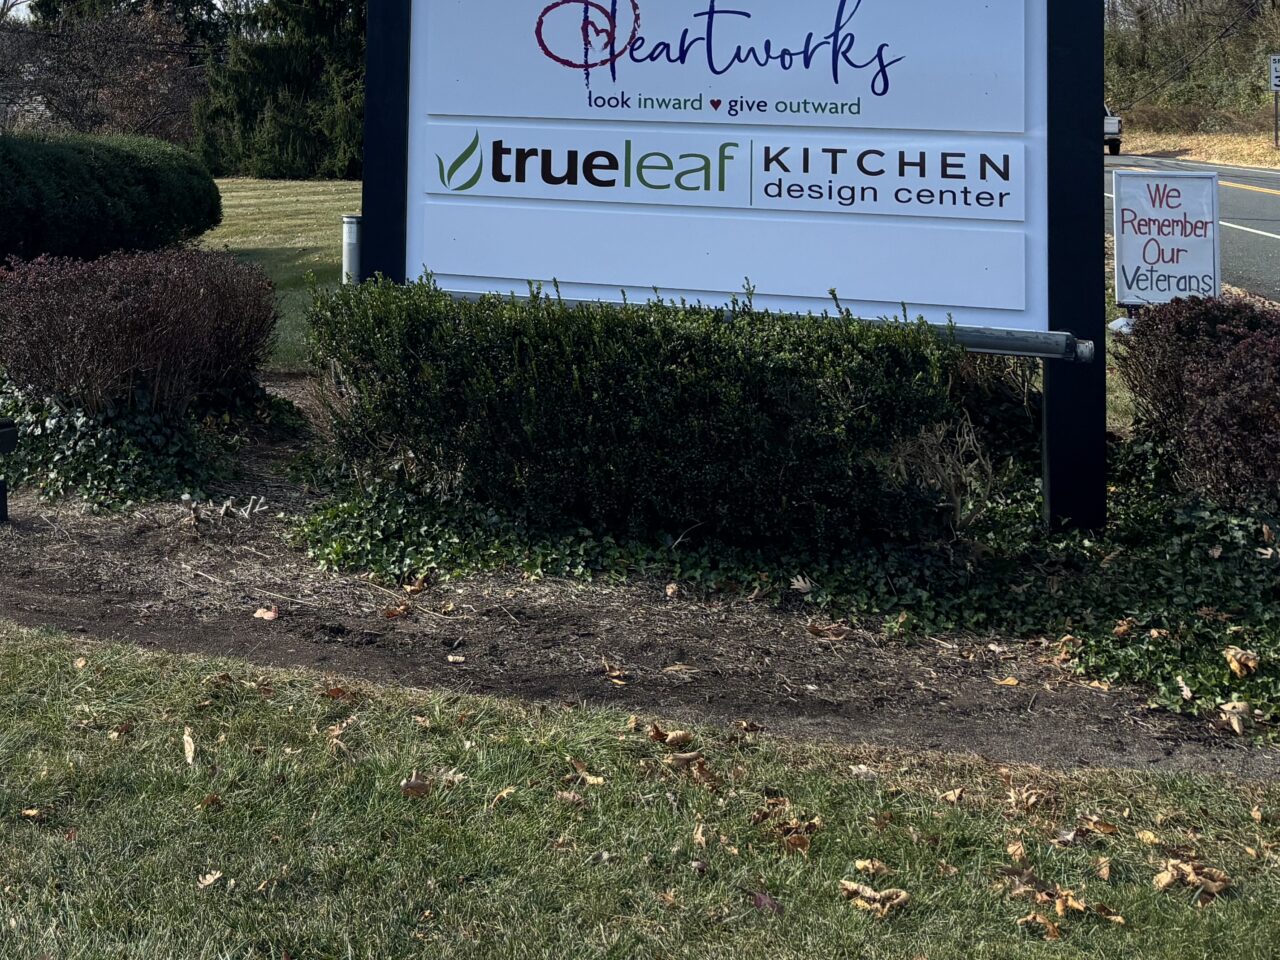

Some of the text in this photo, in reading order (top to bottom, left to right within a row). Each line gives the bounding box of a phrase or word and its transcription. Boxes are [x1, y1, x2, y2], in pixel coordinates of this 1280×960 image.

[588, 91, 861, 117] look inward give outward
[491, 139, 740, 192] trueleaf
[763, 146, 1010, 181] KITCHEN
[763, 178, 1011, 208] design center
[1146, 183, 1182, 209] We
[1121, 208, 1214, 238] Remember
[1142, 237, 1188, 265] Our
[1121, 264, 1213, 293] Veterans
